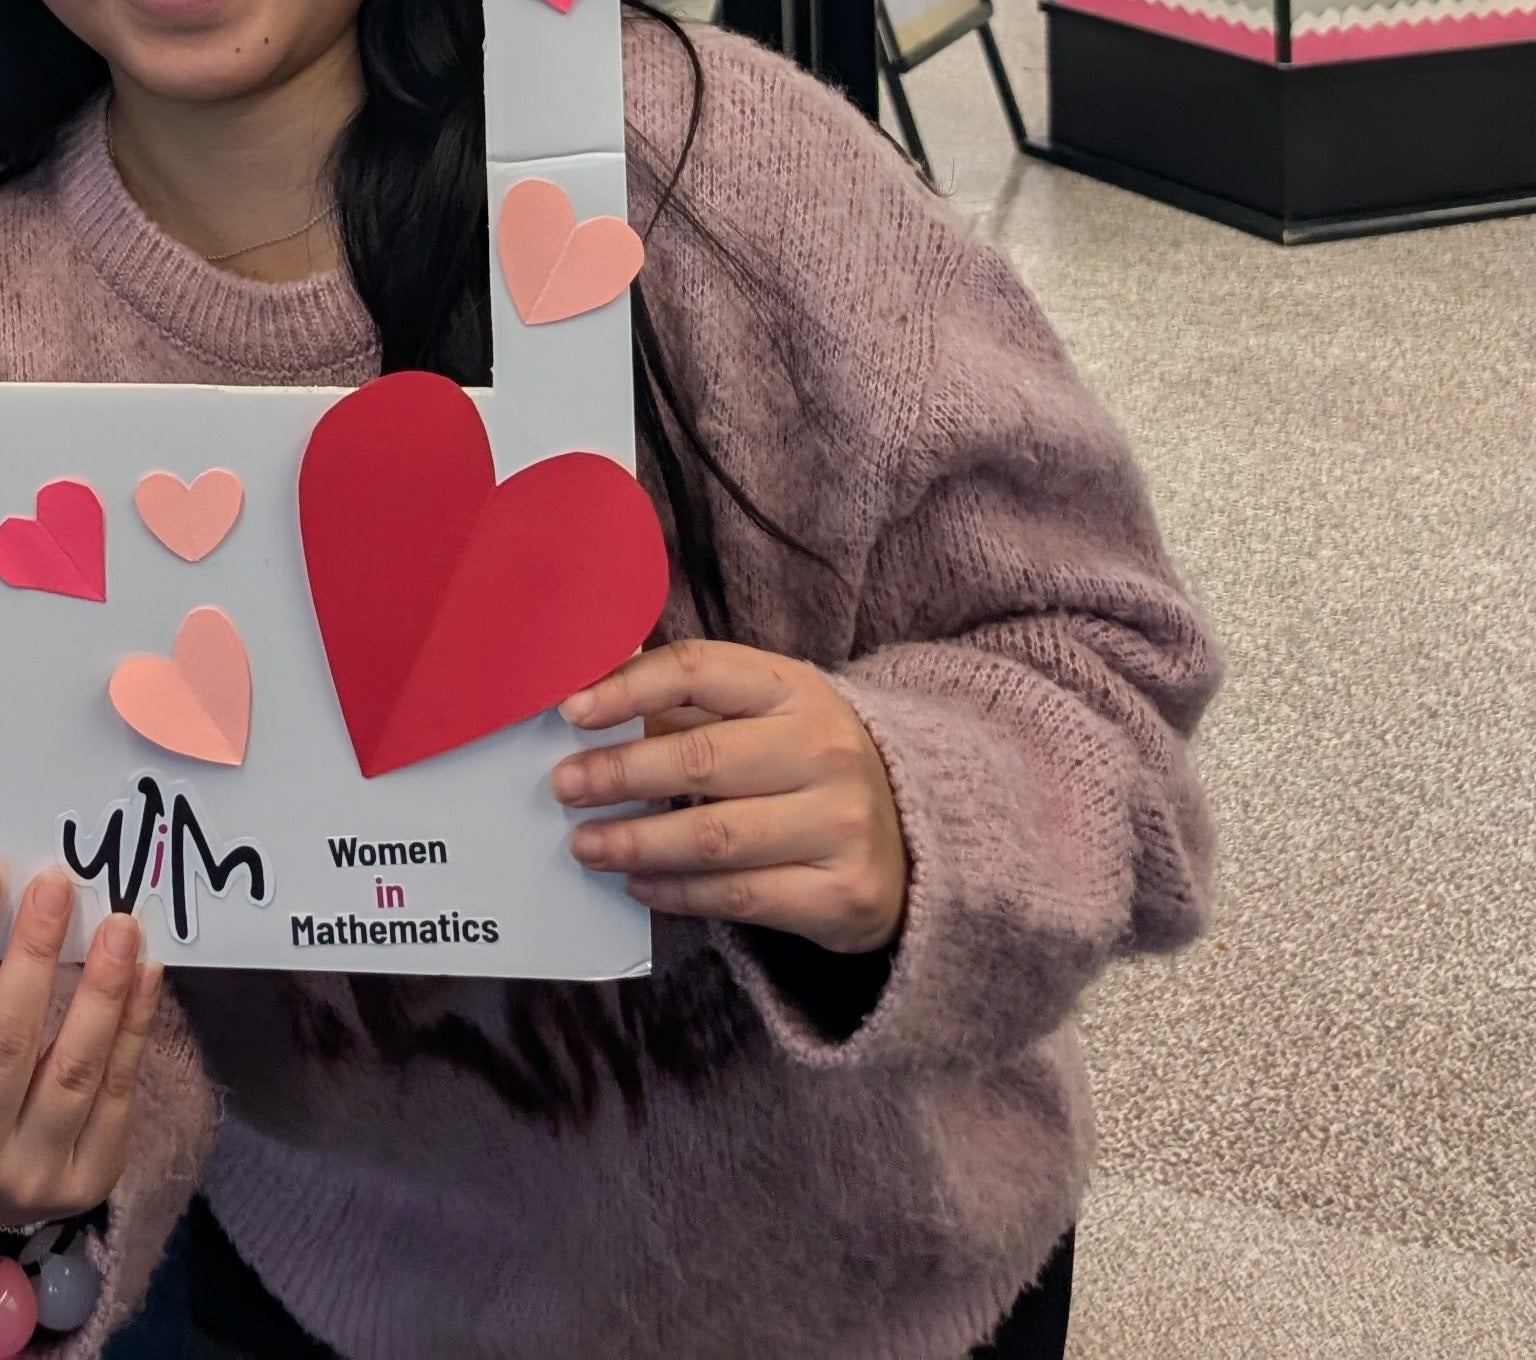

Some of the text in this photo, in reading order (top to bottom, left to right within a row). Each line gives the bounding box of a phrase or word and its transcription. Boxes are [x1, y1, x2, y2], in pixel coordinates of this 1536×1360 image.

[328, 837, 448, 868] Women
[375, 876, 405, 909] in
[290, 911, 500, 946] Mathematics
